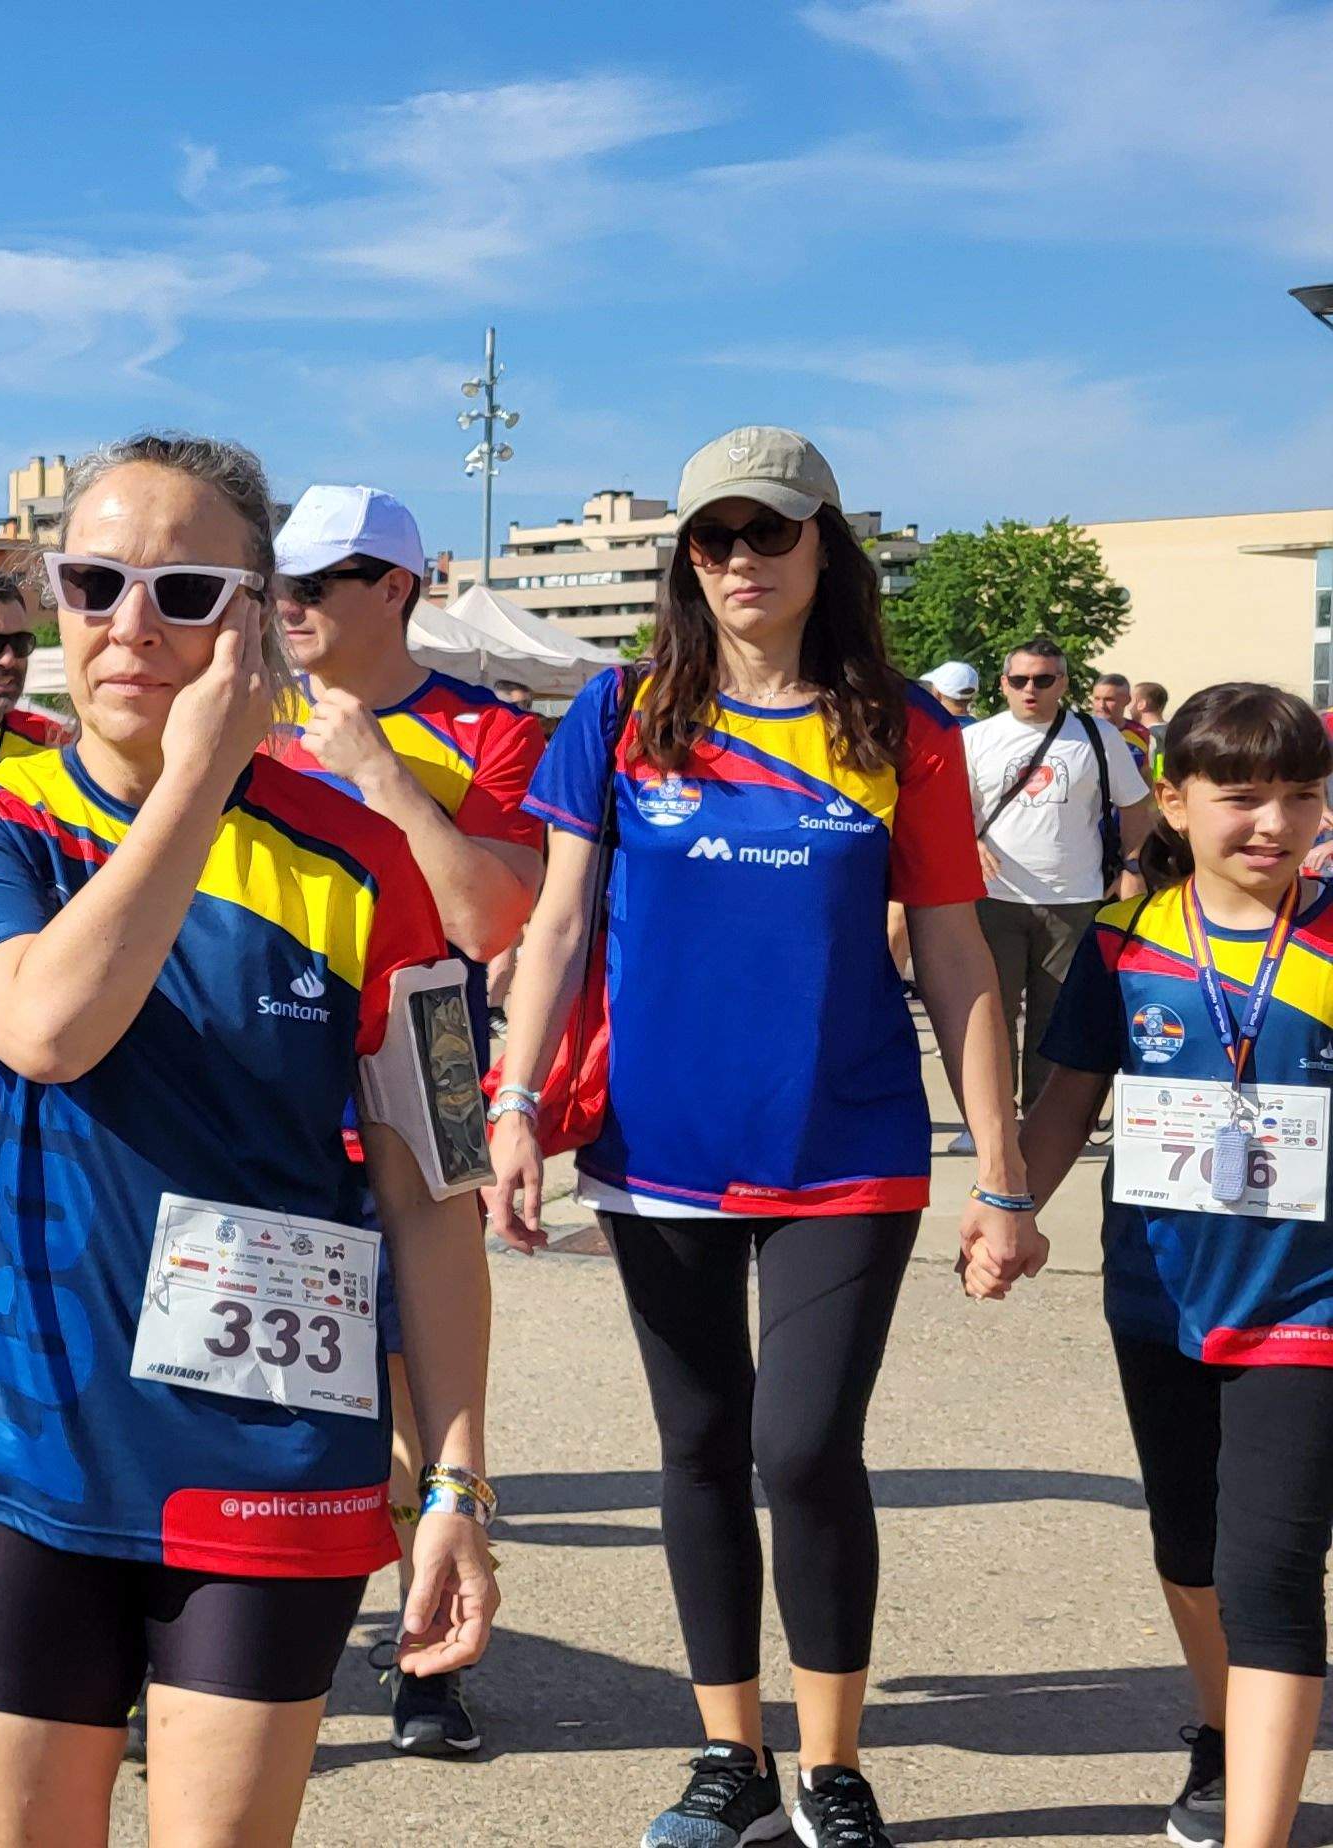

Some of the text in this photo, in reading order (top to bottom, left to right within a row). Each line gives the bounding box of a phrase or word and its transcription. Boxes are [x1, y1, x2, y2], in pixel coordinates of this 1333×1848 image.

[799, 815, 876, 834] Santander
[739, 846, 809, 869] mupol
[203, 1300, 342, 1374] 333
[146, 1362, 210, 1382] #RUTA091
[220, 1492, 382, 1520] @policianacional
